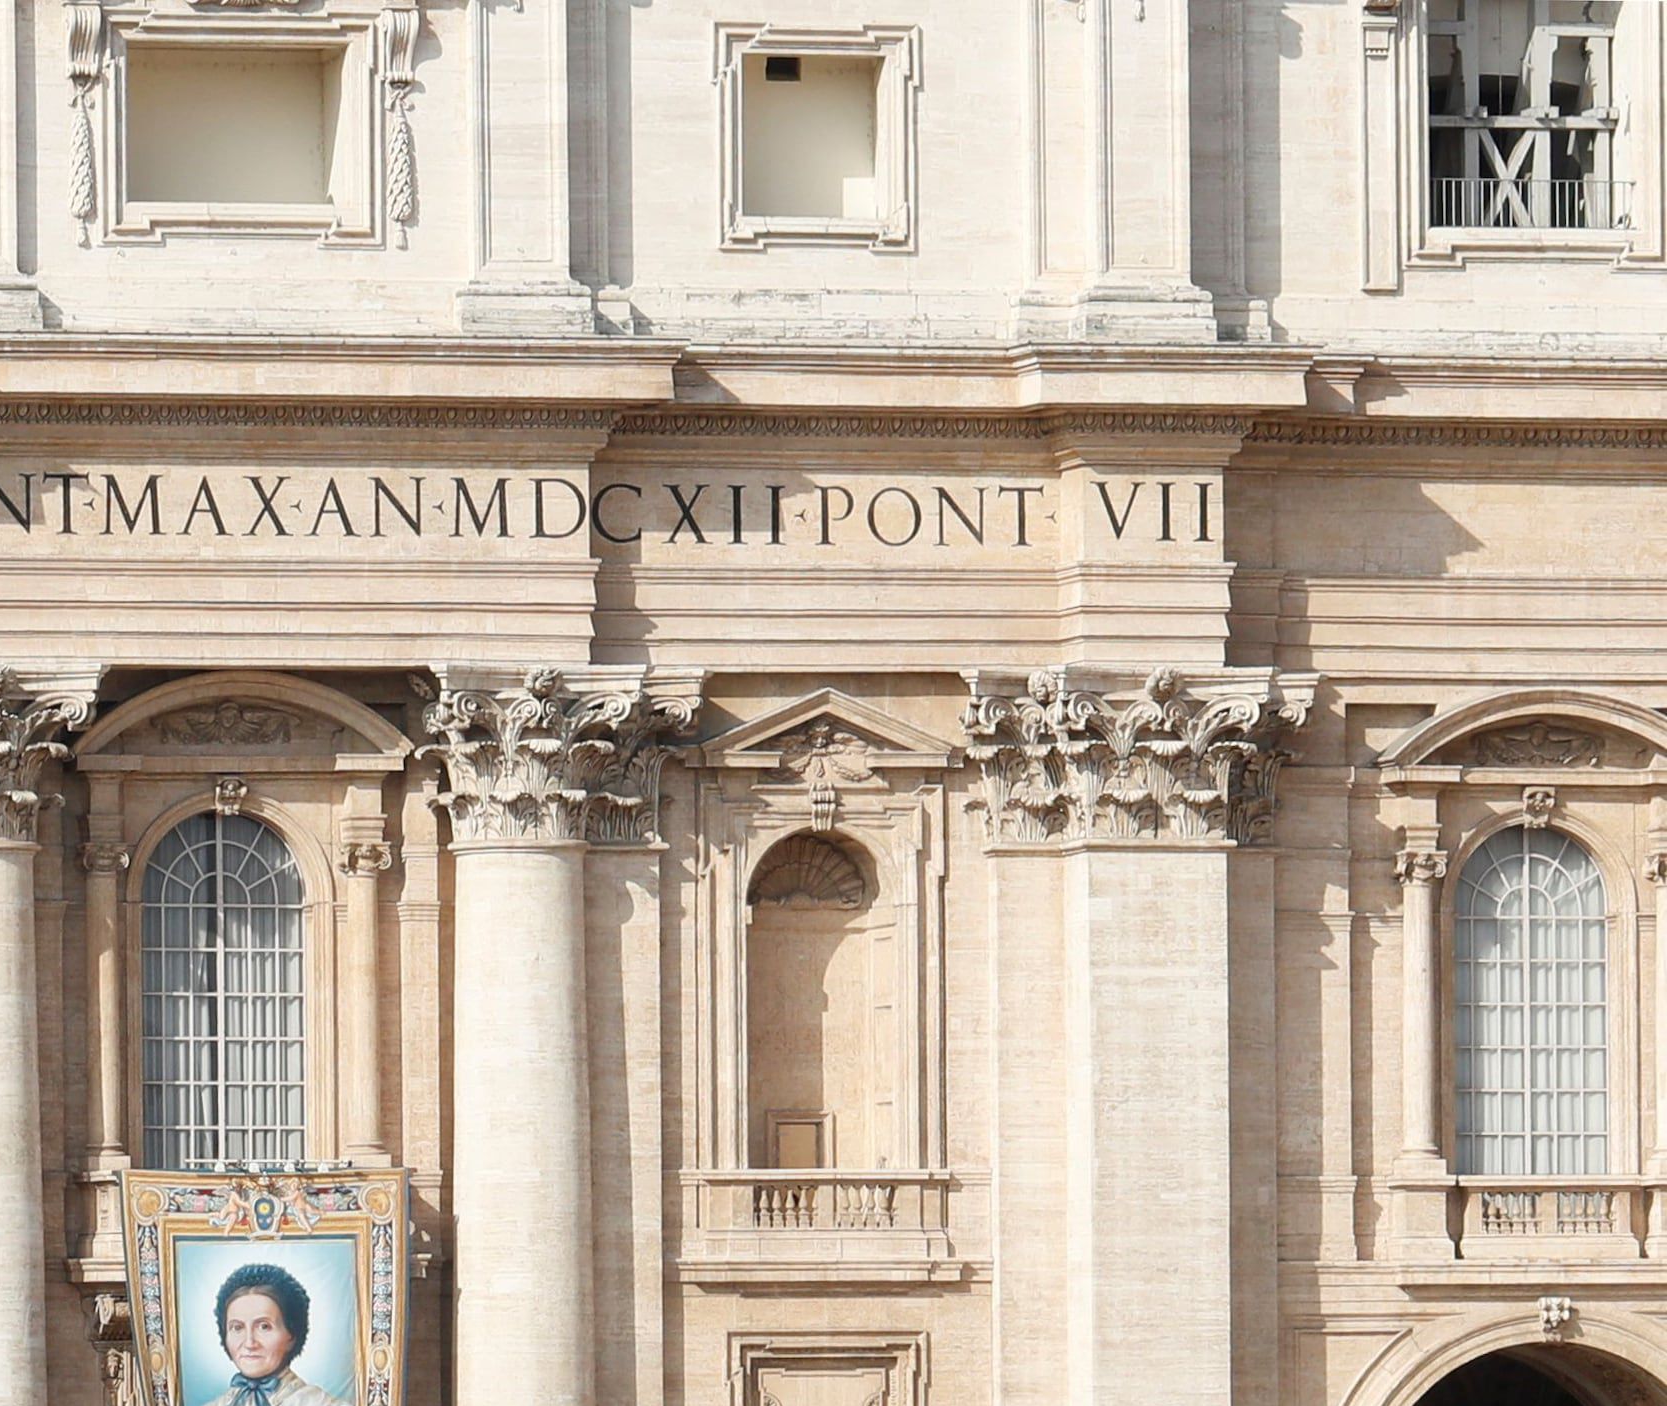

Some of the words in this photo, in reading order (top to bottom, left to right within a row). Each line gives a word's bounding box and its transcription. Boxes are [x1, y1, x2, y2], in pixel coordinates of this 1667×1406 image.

[97, 474, 295, 540] MAX
[303, 476, 423, 541] AN
[447, 477, 787, 549] MDCXII
[814, 484, 1045, 550] PONT
[1089, 481, 1214, 545] VII
